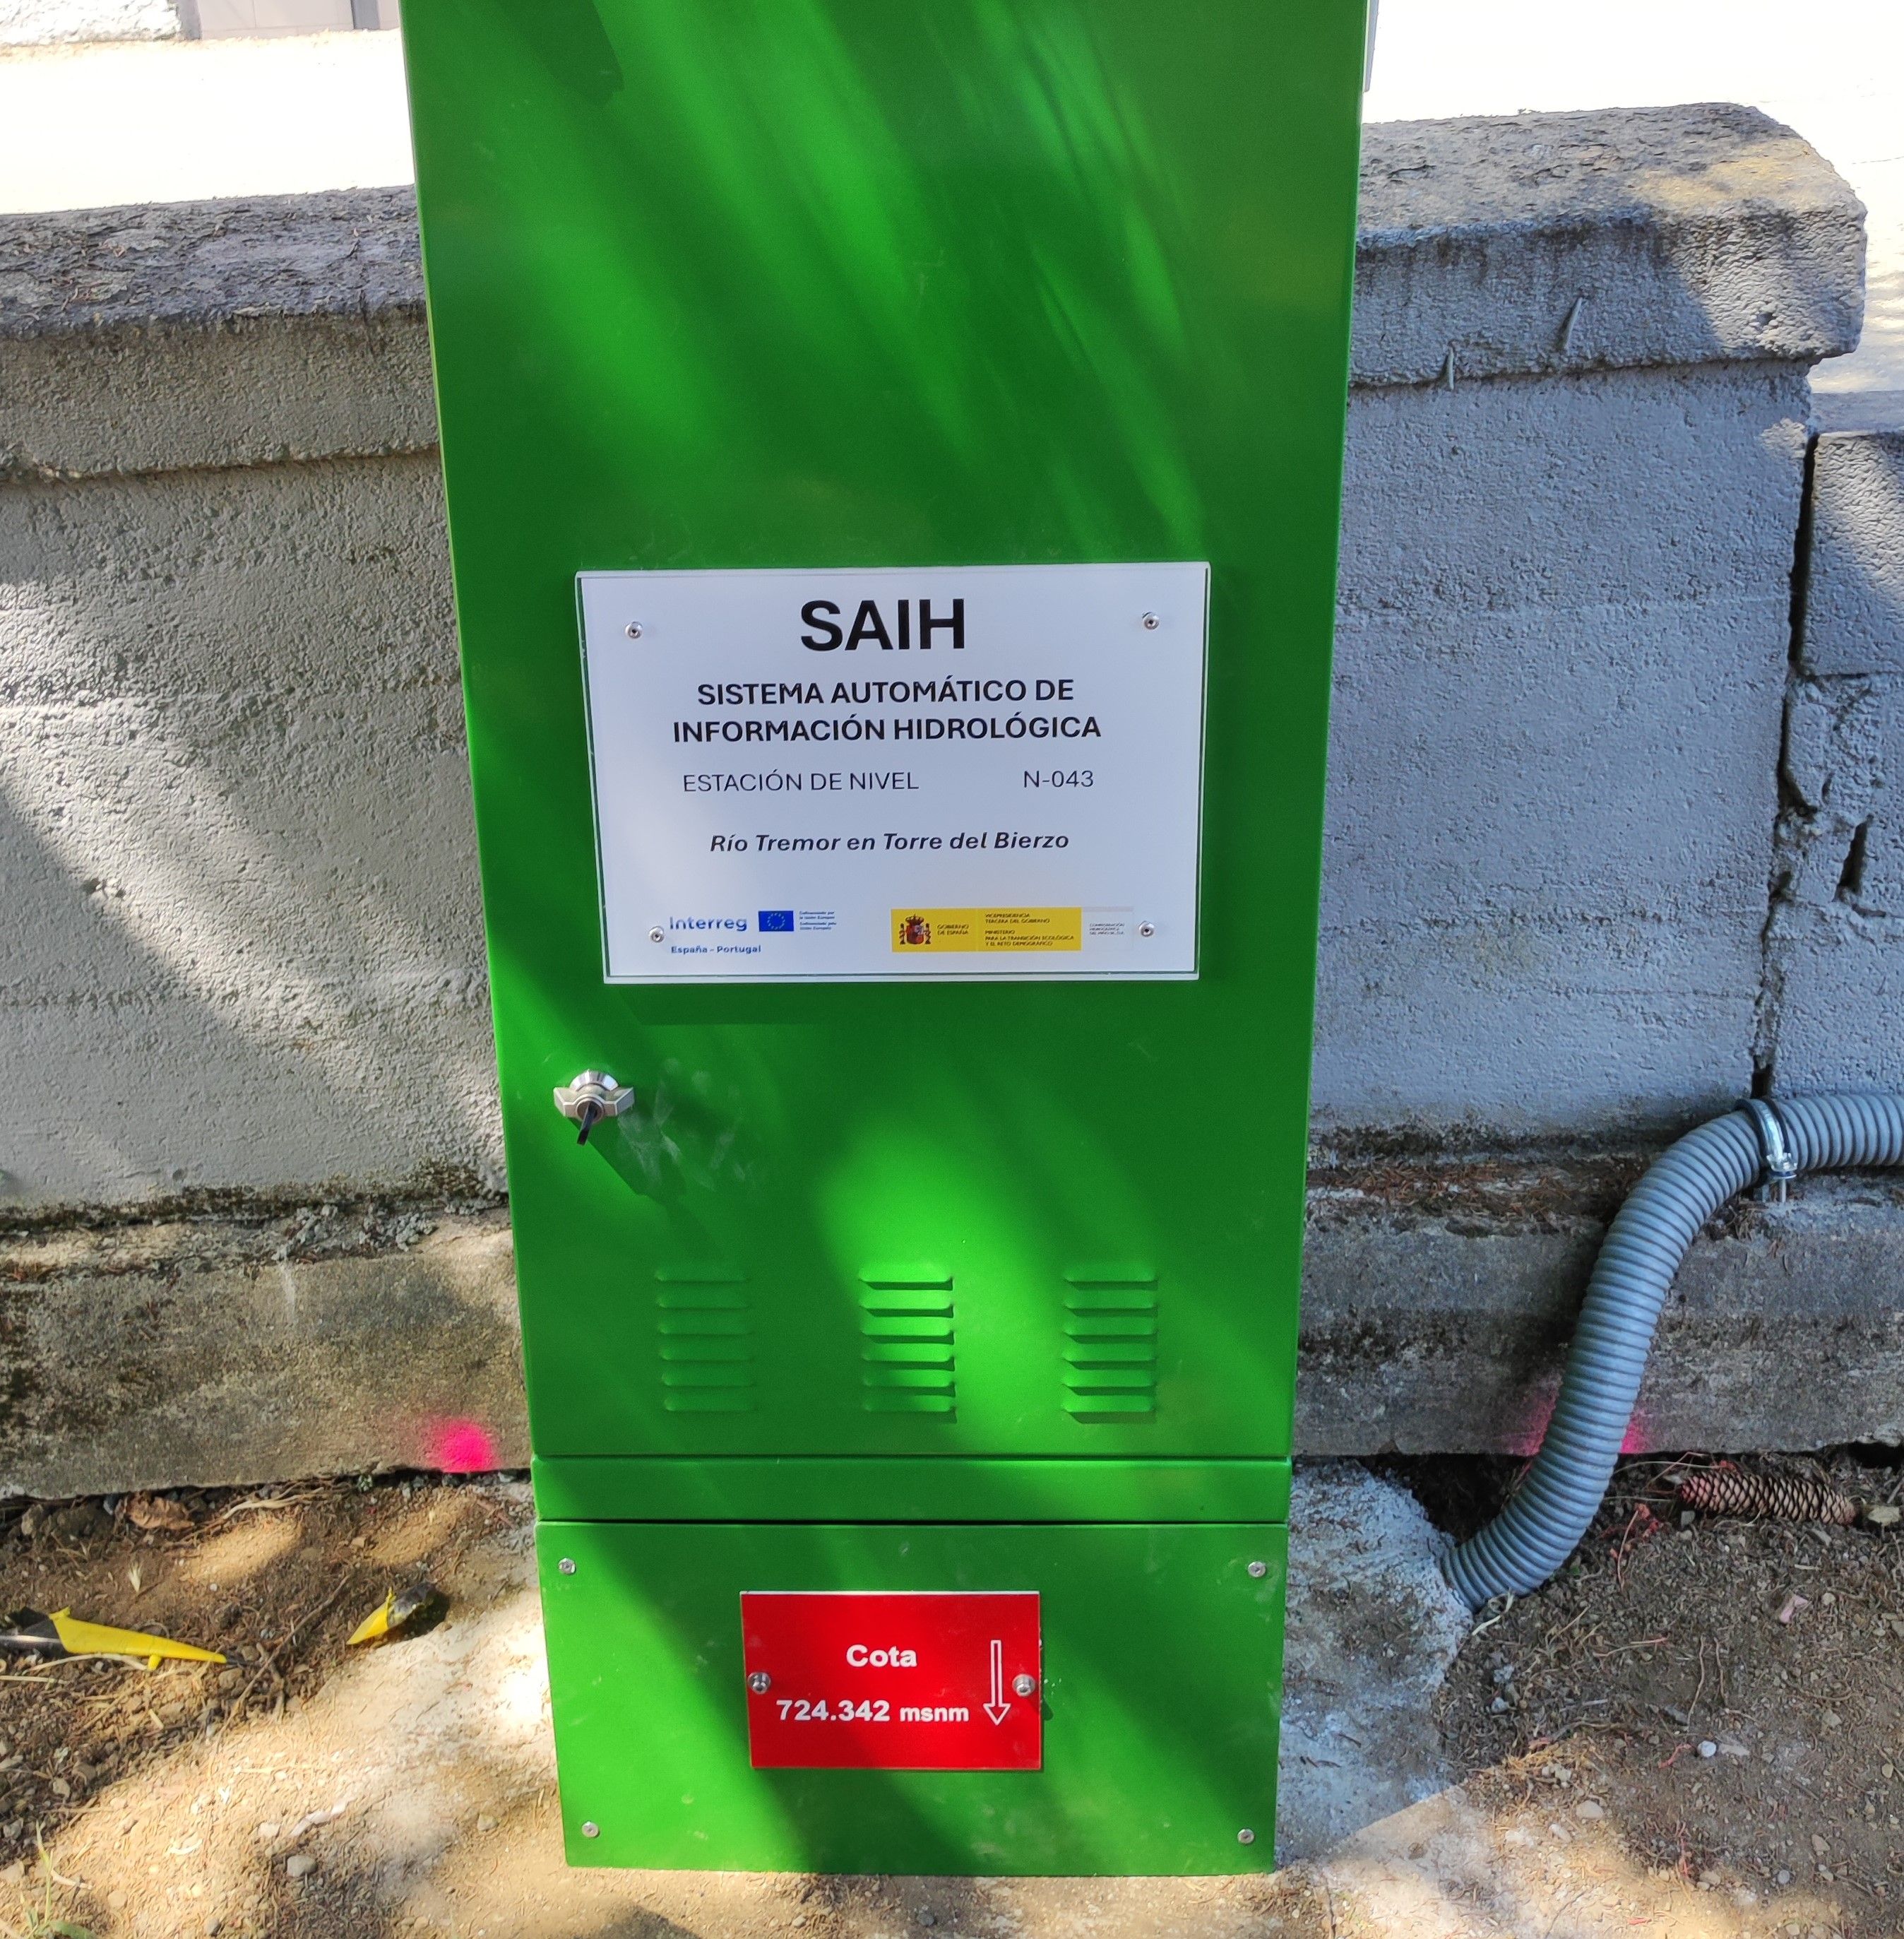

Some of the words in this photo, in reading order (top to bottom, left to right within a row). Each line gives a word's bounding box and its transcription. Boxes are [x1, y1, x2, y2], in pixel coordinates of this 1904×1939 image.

[800, 598, 965, 652] SAIH
[698, 682, 824, 706] SISTEMA
[831, 675, 1027, 704] AUTOMÁTICO
[1035, 679, 1074, 701] DE
[673, 713, 885, 743] INFORMACIÓN
[894, 711, 1102, 740] HIDROLÓGICA
[683, 768, 802, 792] ESTACIÓN
[810, 772, 843, 791] DE
[850, 771, 920, 790] NIVEL
[1023, 769, 1094, 788] N-043
[710, 834, 748, 852] Río
[755, 834, 842, 852] Tremor
[847, 837, 876, 851] en
[883, 832, 943, 850] Torre
[949, 831, 988, 850] del
[994, 831, 1069, 849] Bierzo
[670, 916, 747, 932] Interreg
[671, 945, 708, 954] España
[717, 944, 761, 954] Portugal
[845, 1643, 918, 1668] Cota
[776, 1699, 891, 1722] 724.342
[899, 1705, 970, 1722] msnm
